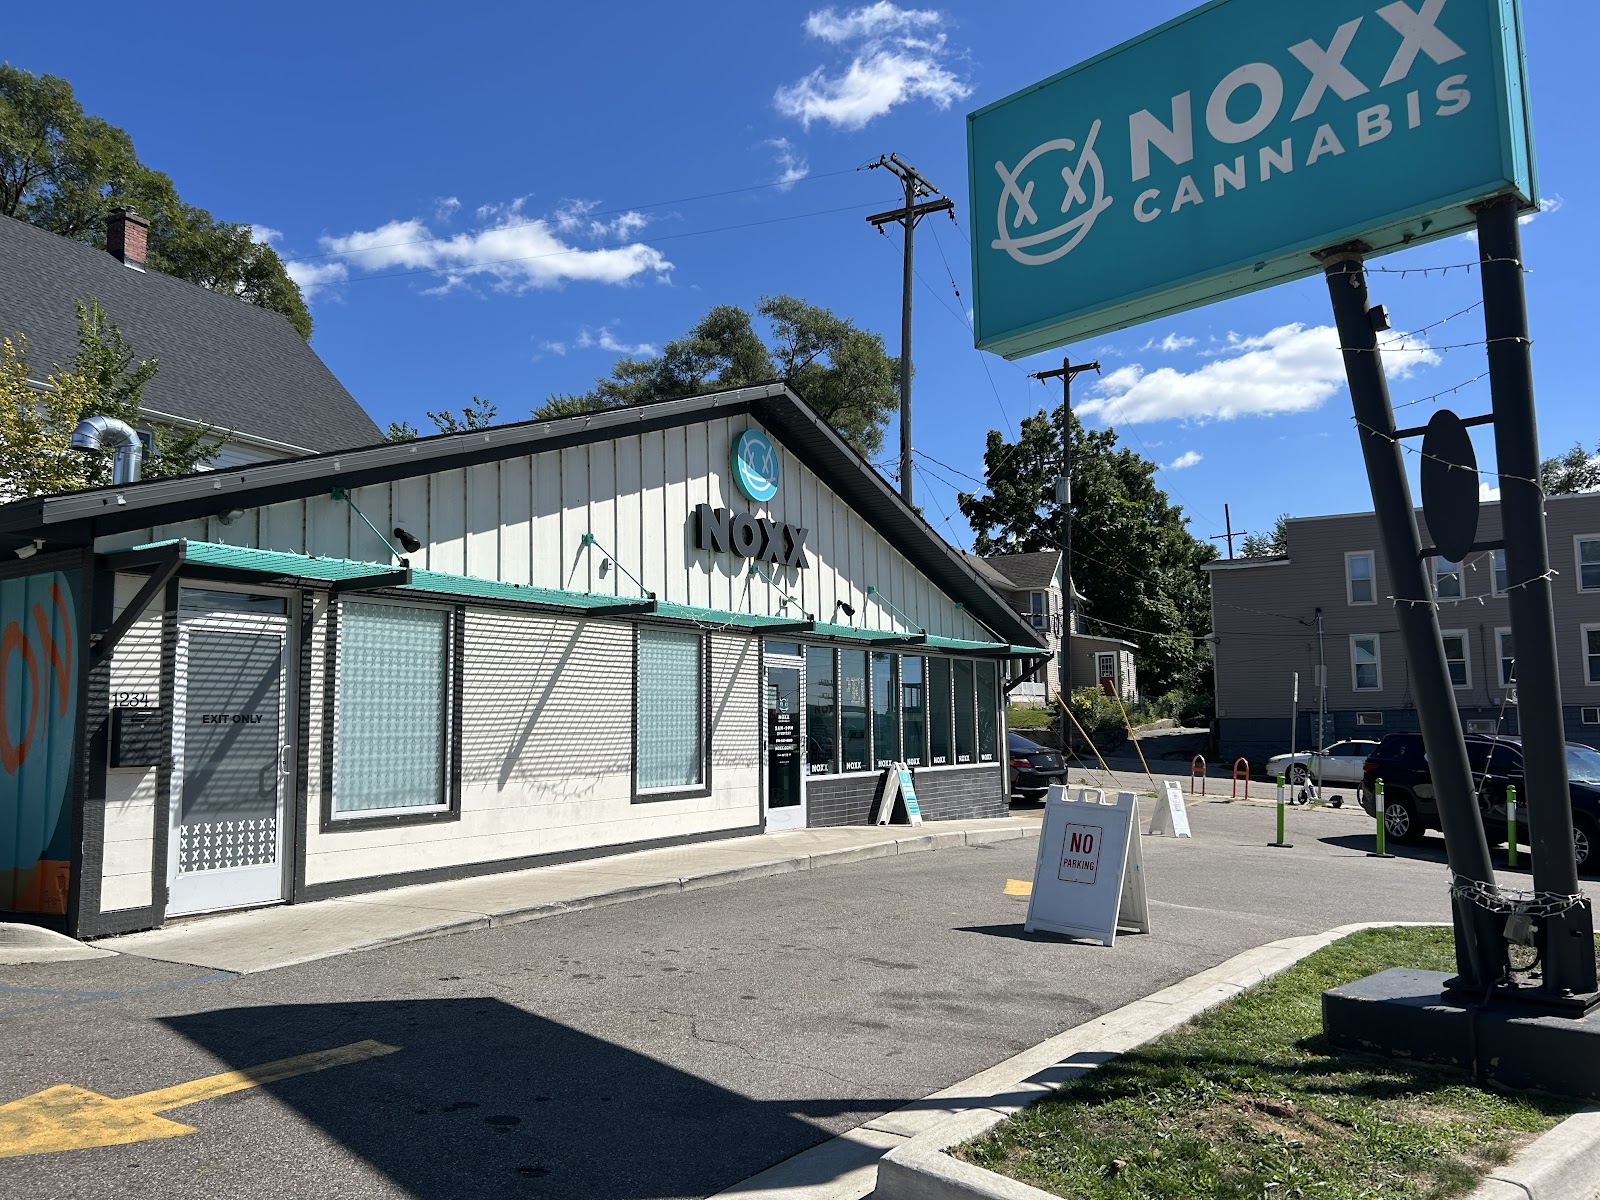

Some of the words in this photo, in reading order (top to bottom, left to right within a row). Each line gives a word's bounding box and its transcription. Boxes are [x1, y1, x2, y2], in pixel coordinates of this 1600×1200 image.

[1129, 0, 1467, 182] NOXX
[1133, 74, 1472, 223] CANNABIS
[696, 502, 810, 569] NOXX
[112, 691, 150, 707] 1234
[202, 714, 230, 724] EXIT
[232, 714, 263, 724] ONLY
[812, 763, 828, 772] NOXX
[846, 761, 861, 770] NOXX
[878, 759, 892, 767] NOXX
[907, 757, 920, 765] NOXX
[1070, 832, 1094, 854] NO
[1063, 858, 1095, 871] PARKING
